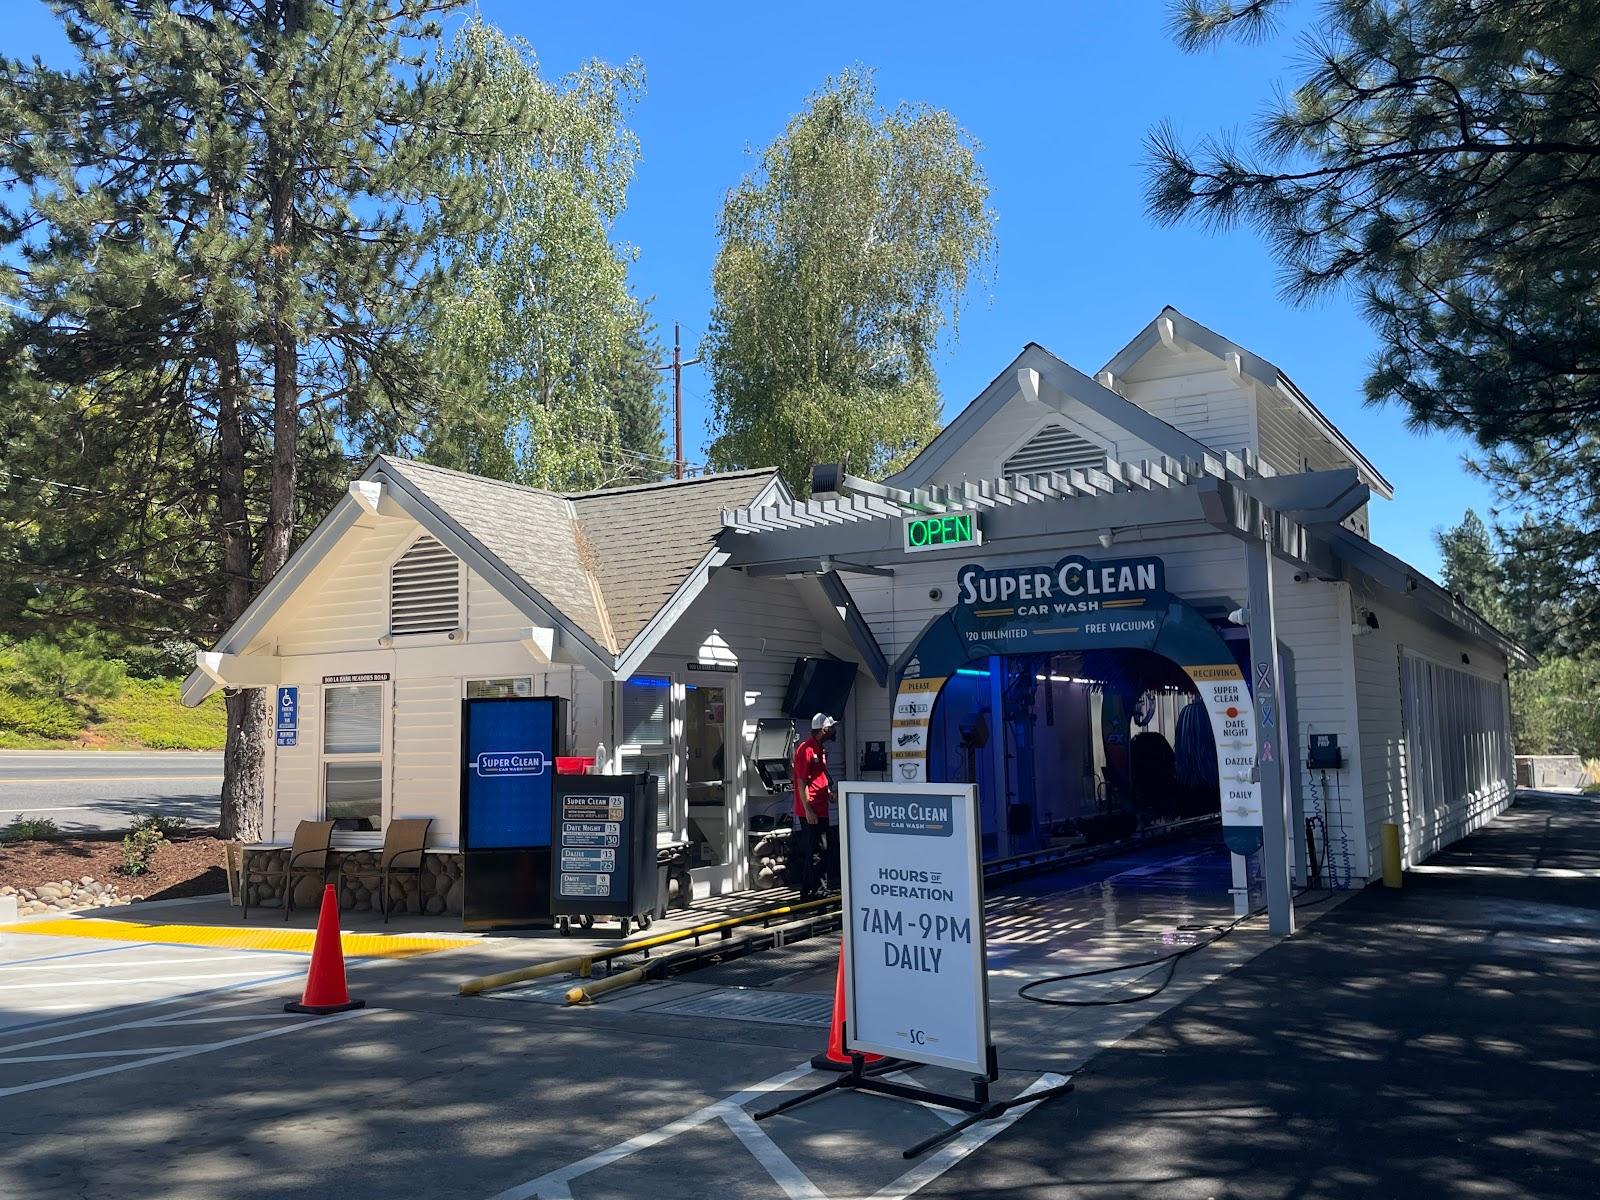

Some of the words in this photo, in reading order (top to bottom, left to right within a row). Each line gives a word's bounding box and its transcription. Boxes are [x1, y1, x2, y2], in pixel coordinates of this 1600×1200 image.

[909, 515, 972, 547] OPEN
[963, 571, 1052, 605] SUPER
[1058, 562, 1156, 597] CLEAN
[1017, 603, 1049, 616] CAR
[1053, 600, 1099, 614] WASH
[1085, 623, 1107, 634] FREE
[1109, 619, 1155, 632] VACUUMS
[965, 630, 979, 641] $20
[980, 628, 1028, 640] UNLIMITED
[1193, 668, 1237, 678] RECEIVING
[908, 682, 930, 691] PLEASE
[1213, 686, 1238, 695] SUPER
[1214, 694, 1239, 703] CLEAN
[1225, 720, 1245, 729] DATE
[1223, 728, 1248, 737] NIGHT
[482, 756, 510, 768] SUPER
[511, 755, 540, 767] CLEAN
[1225, 757, 1253, 766] DAZZLE
[567, 797, 586, 805] SUPER
[587, 797, 607, 805] CLEAN
[610, 797, 622, 805] $25
[1229, 790, 1252, 800] DAILY
[868, 801, 906, 820] SUPER
[908, 803, 948, 822] CLEAN
[582, 824, 601, 832] NIGHT
[878, 867, 929, 883] HOURS
[870, 884, 953, 902] OPERATION
[884, 941, 942, 973] DAILY
[910, 1028, 925, 1045] SC
